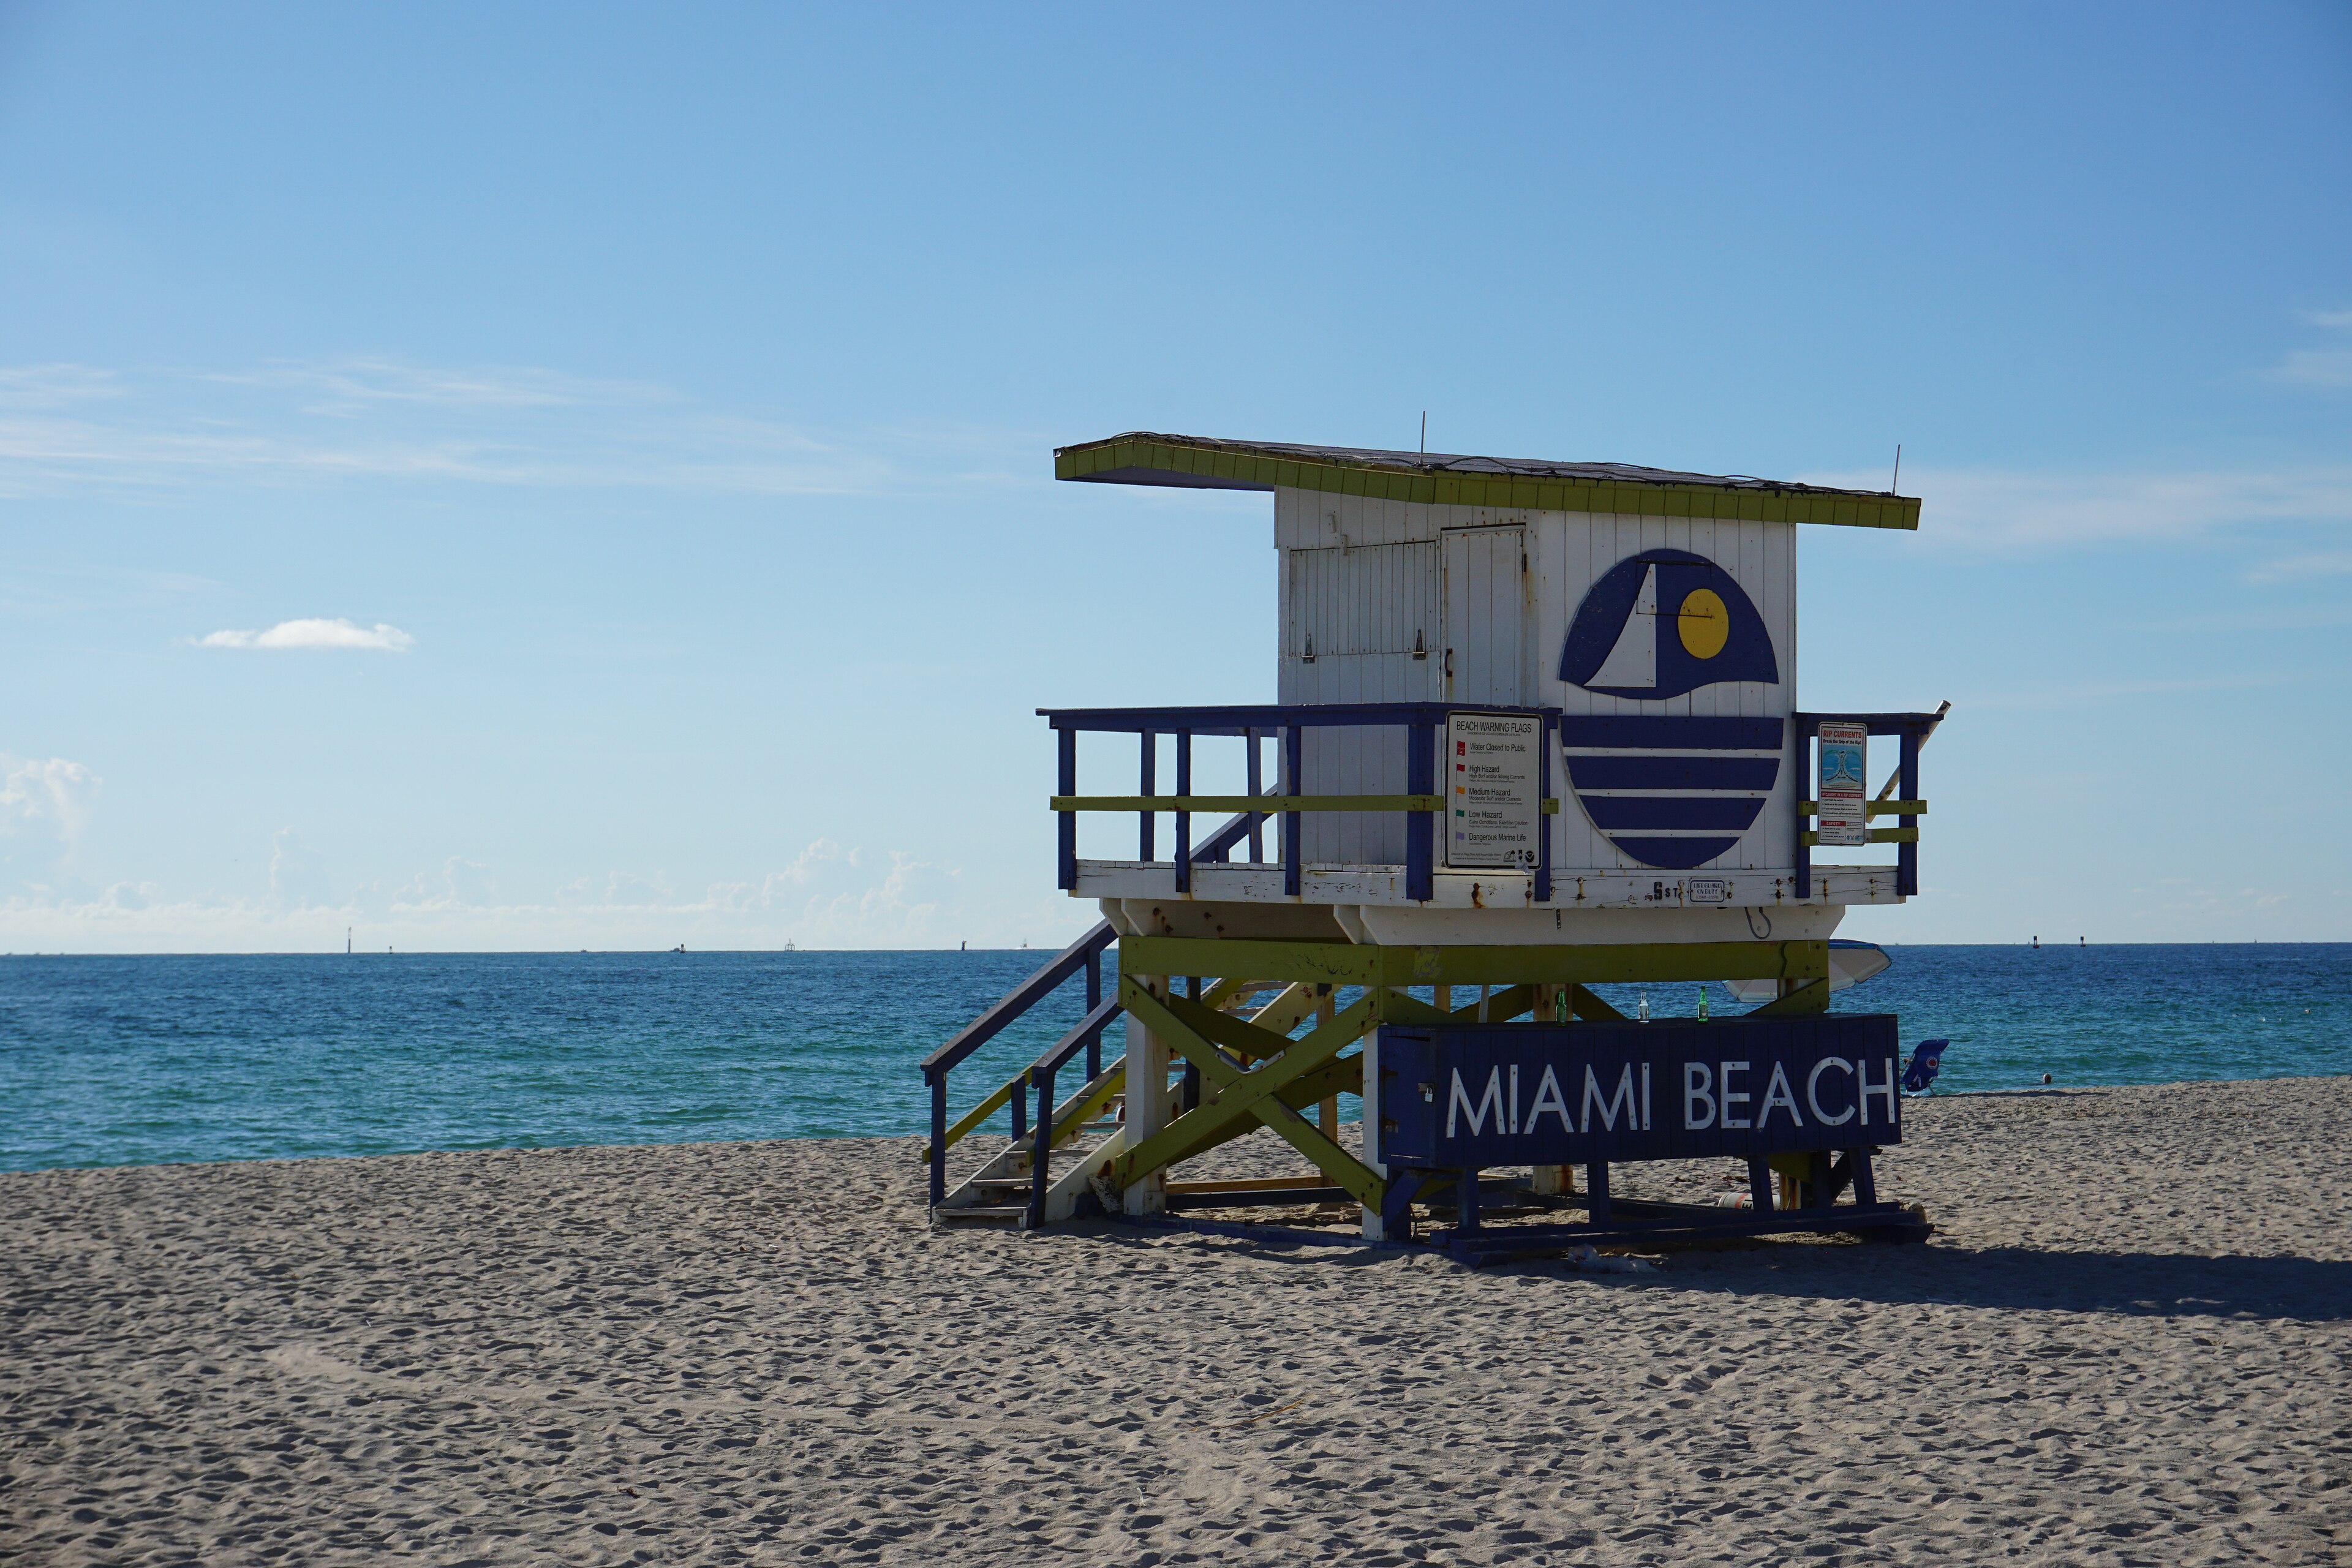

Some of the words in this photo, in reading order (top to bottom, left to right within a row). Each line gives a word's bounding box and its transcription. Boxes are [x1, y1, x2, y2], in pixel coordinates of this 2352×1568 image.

[1457, 721, 1478, 731] BEACH
[1480, 722, 1509, 732] WARNING
[1511, 723, 1531, 733] FLAGS
[1469, 764, 1480, 774] High
[1469, 833, 1497, 842] Dangerous
[1446, 1063, 1651, 1138] MIAMI
[1684, 1057, 1895, 1131] BEACH
